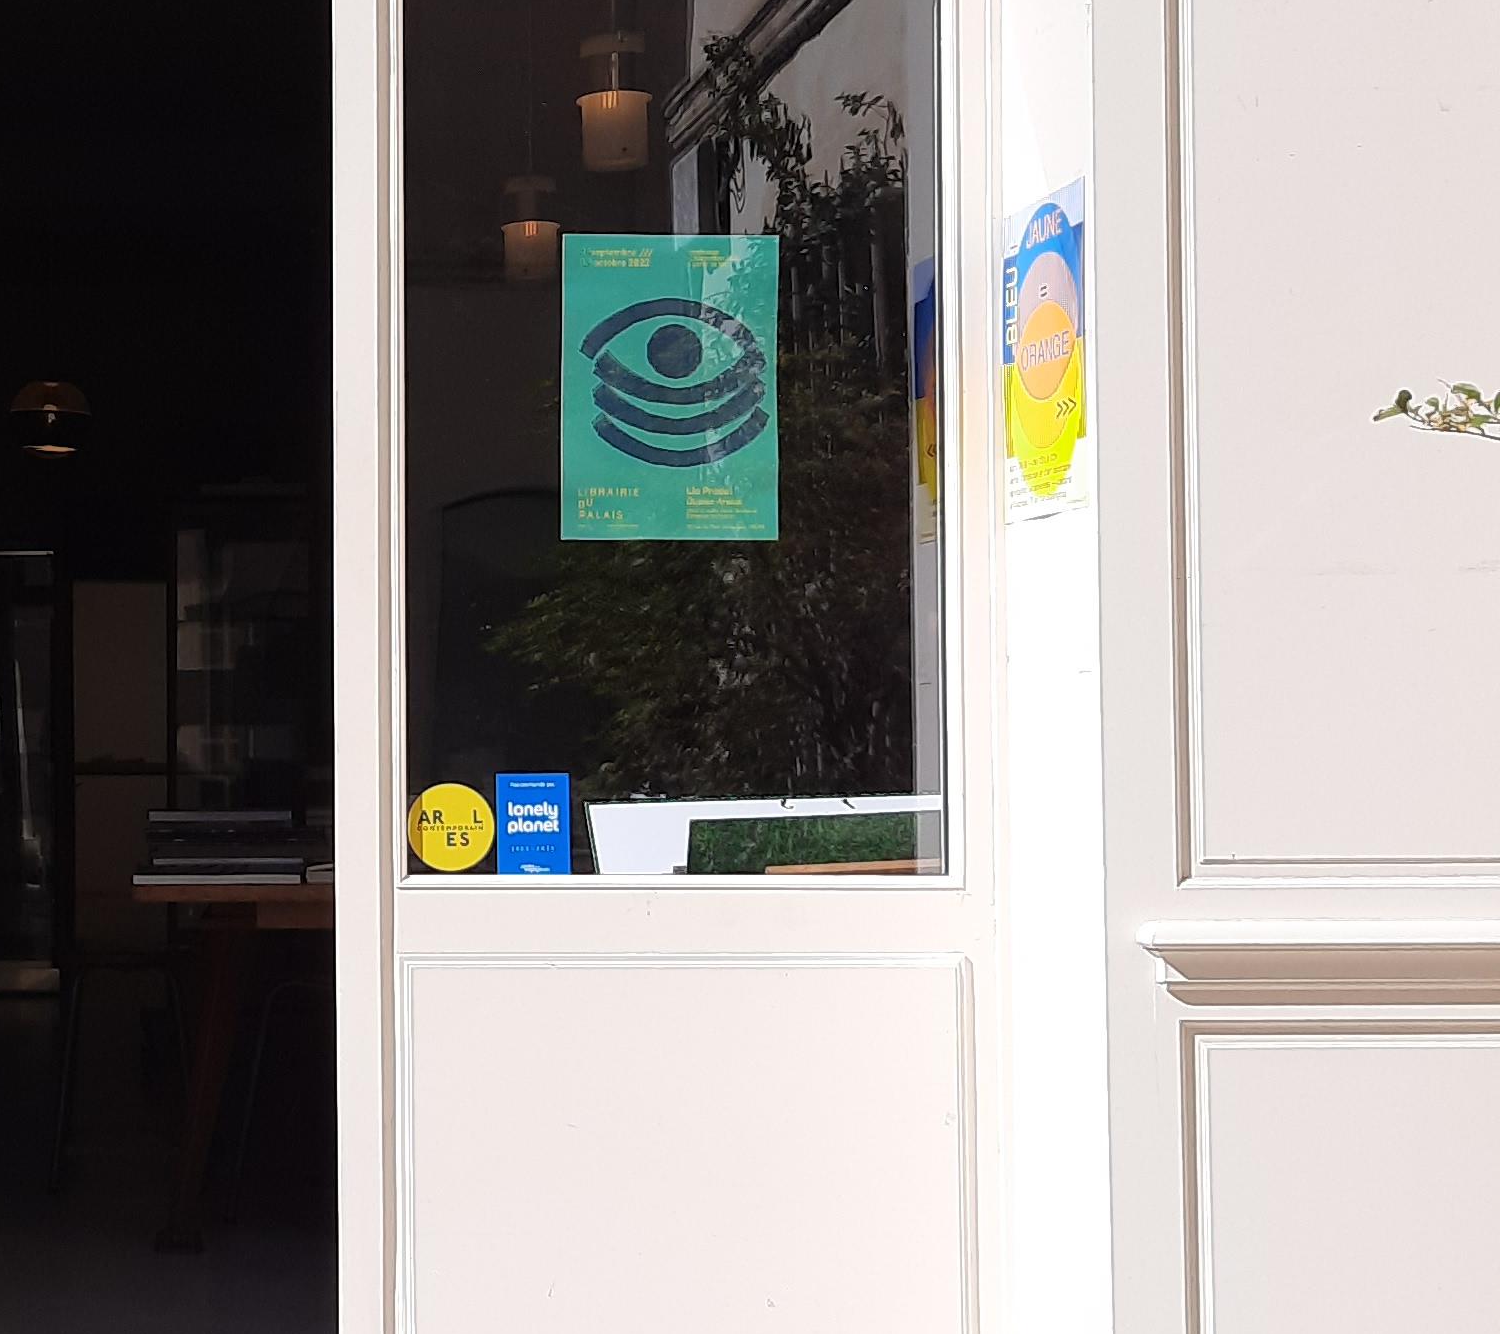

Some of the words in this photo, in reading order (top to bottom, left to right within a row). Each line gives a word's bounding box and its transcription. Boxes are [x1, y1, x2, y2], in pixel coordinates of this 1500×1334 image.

[1026, 208, 1063, 250] JAUNE
[1006, 267, 1018, 346] BLEU
[1021, 330, 1070, 371] ORANGE
[578, 487, 640, 497] LIBRAIRIE
[579, 510, 624, 520] PALAIS
[507, 801, 559, 819] lonely
[507, 817, 560, 835] planet
[446, 832, 470, 846] ES
